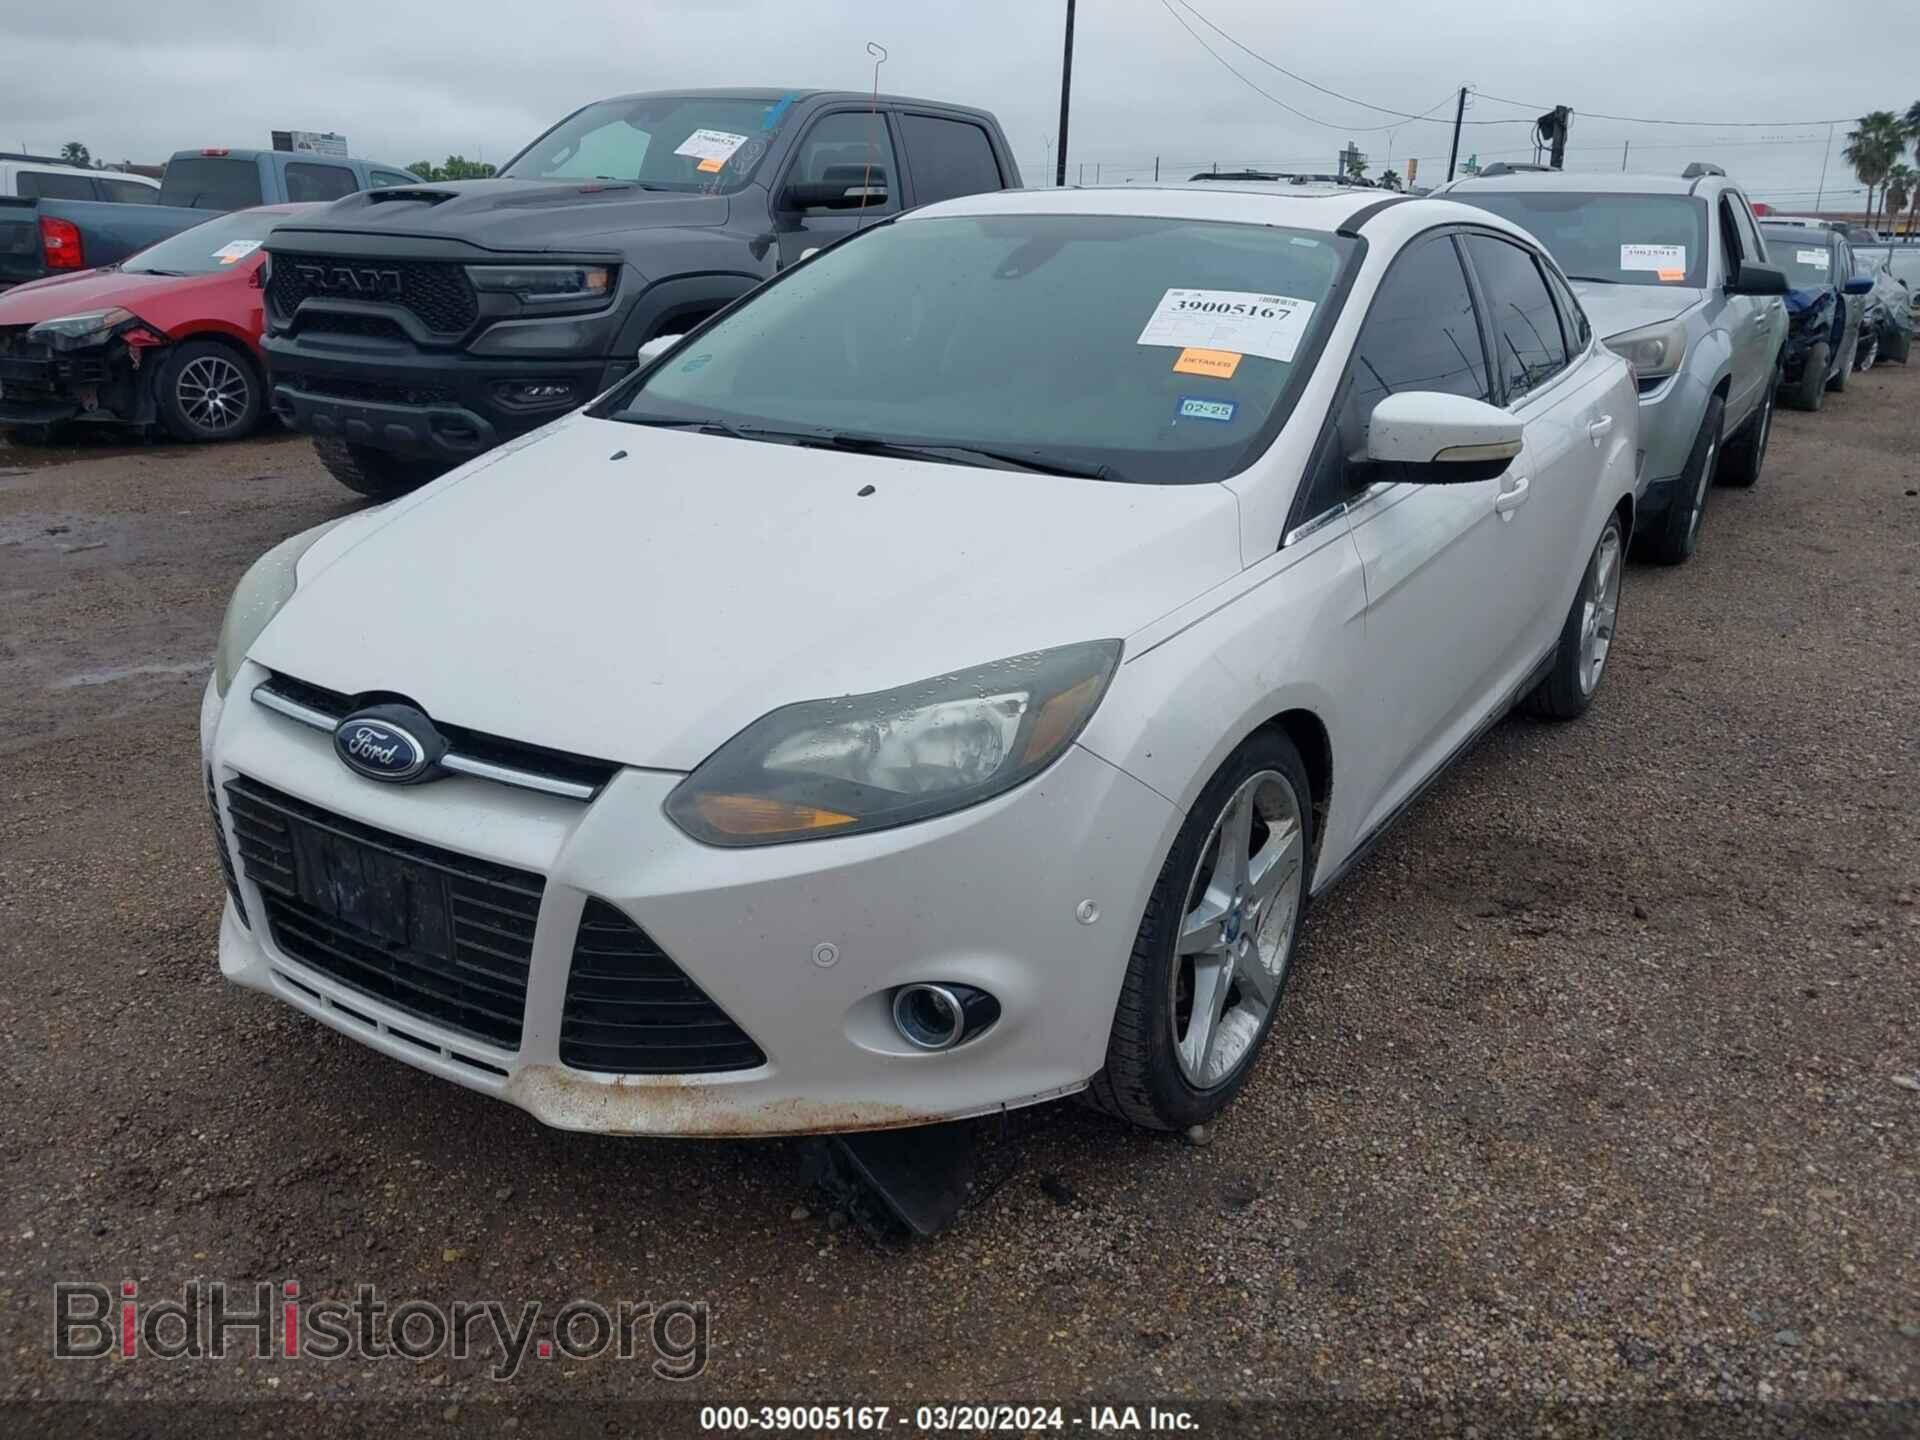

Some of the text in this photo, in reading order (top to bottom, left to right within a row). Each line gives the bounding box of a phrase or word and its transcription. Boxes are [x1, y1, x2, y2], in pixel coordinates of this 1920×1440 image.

[294, 264, 402, 293] RAM
[1171, 300, 1292, 321] 39005167
[1183, 356, 1232, 369] DETAILED
[1184, 402, 1230, 416] 02-25
[348, 727, 399, 764] Ford
